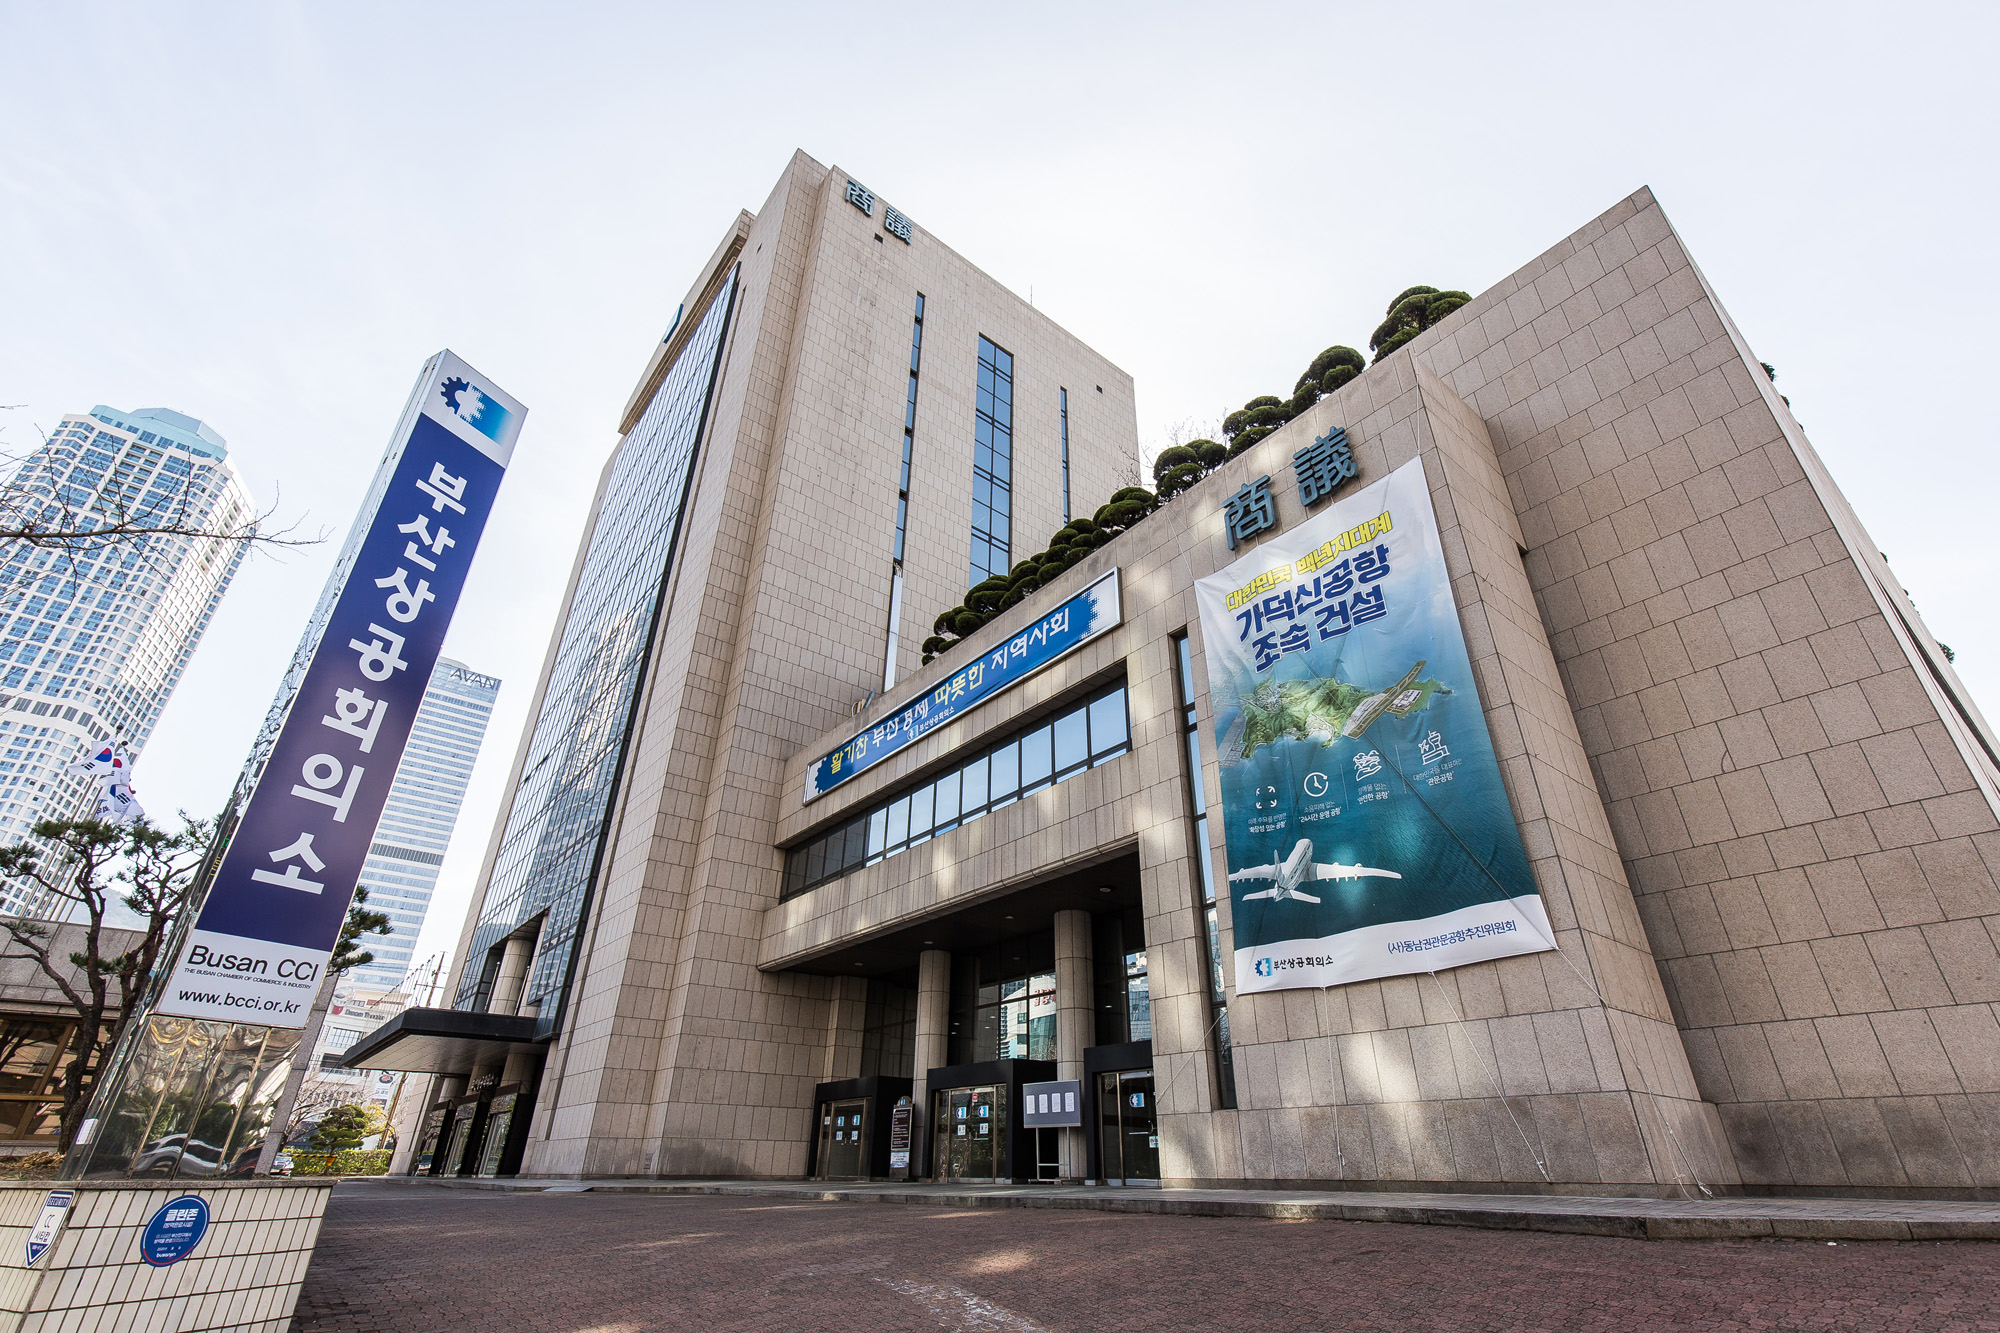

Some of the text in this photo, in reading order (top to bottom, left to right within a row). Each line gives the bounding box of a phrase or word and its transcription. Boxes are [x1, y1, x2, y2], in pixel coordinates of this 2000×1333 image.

[1221, 426, 1358, 551] 商議
[1225, 510, 1393, 612] 대한민국 백년지대계
[1236, 543, 1391, 643] 가덕신공항
[1252, 583, 1388, 673] 조속 건설
[251, 461, 467, 895] 부산상공회의소
[830, 734, 868, 775] 활기찬
[872, 716, 899, 748] 부산
[934, 661, 985, 706] 따뜻한
[991, 607, 1069, 670] 지역사회
[187, 944, 319, 982] Busan CCI
[1273, 954, 1334, 971] 부산상공회의소
[1387, 920, 1517, 954] (사)동남권관문공항추진위원회
[179, 990, 301, 1014] www.bcci.or.kr
[196, 969, 216, 977] BUSAN
[216, 972, 244, 981] CHAMBER
[252, 977, 282, 986] COMMERCE
[165, 1208, 199, 1221] 클린존
